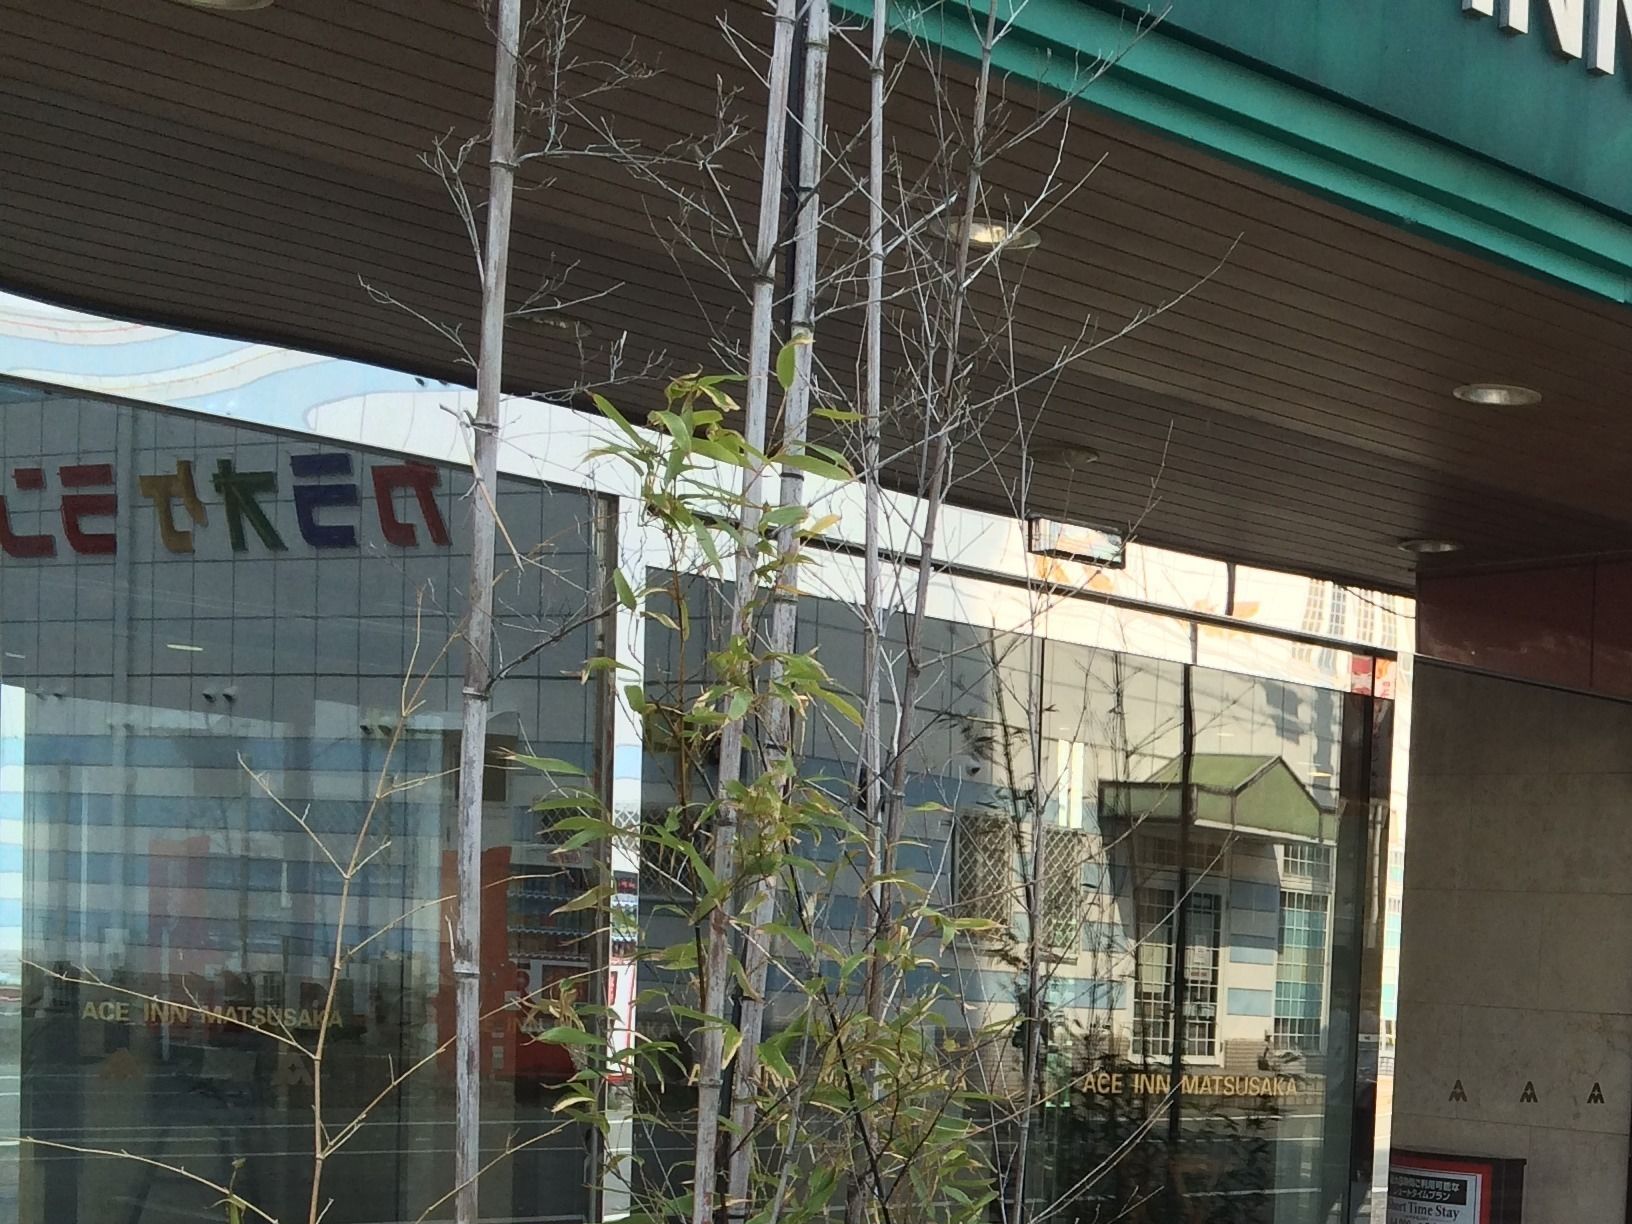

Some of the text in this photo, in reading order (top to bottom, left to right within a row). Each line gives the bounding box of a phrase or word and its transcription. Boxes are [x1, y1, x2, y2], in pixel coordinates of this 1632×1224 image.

[81, 1001, 344, 1029] ACE INN MATSUSAKA
[1082, 1073, 1298, 1097] ACE INN MATSUSAKA
[1408, 1201, 1434, 1217] Time
[1435, 1204, 1460, 1221] Stay
